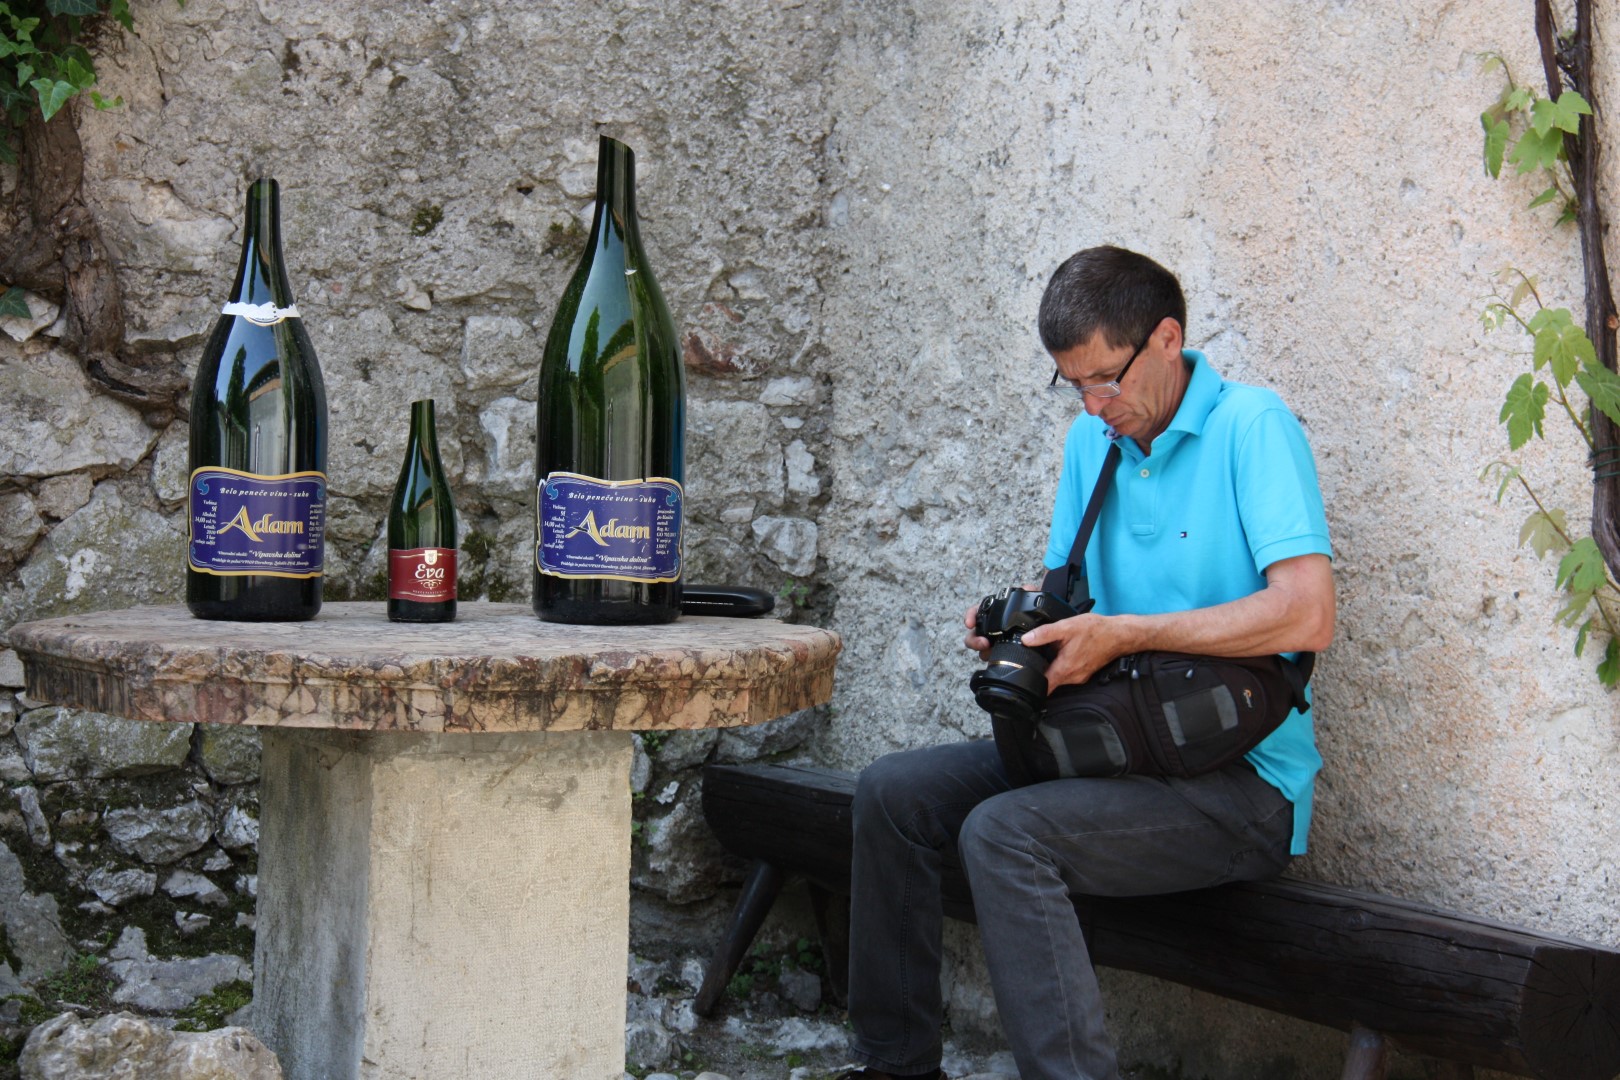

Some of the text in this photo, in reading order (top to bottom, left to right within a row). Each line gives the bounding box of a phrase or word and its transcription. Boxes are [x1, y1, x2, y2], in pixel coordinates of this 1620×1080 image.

[216, 505, 304, 542] Adam
[565, 509, 650, 546] Adam
[415, 564, 445, 579] Eva
